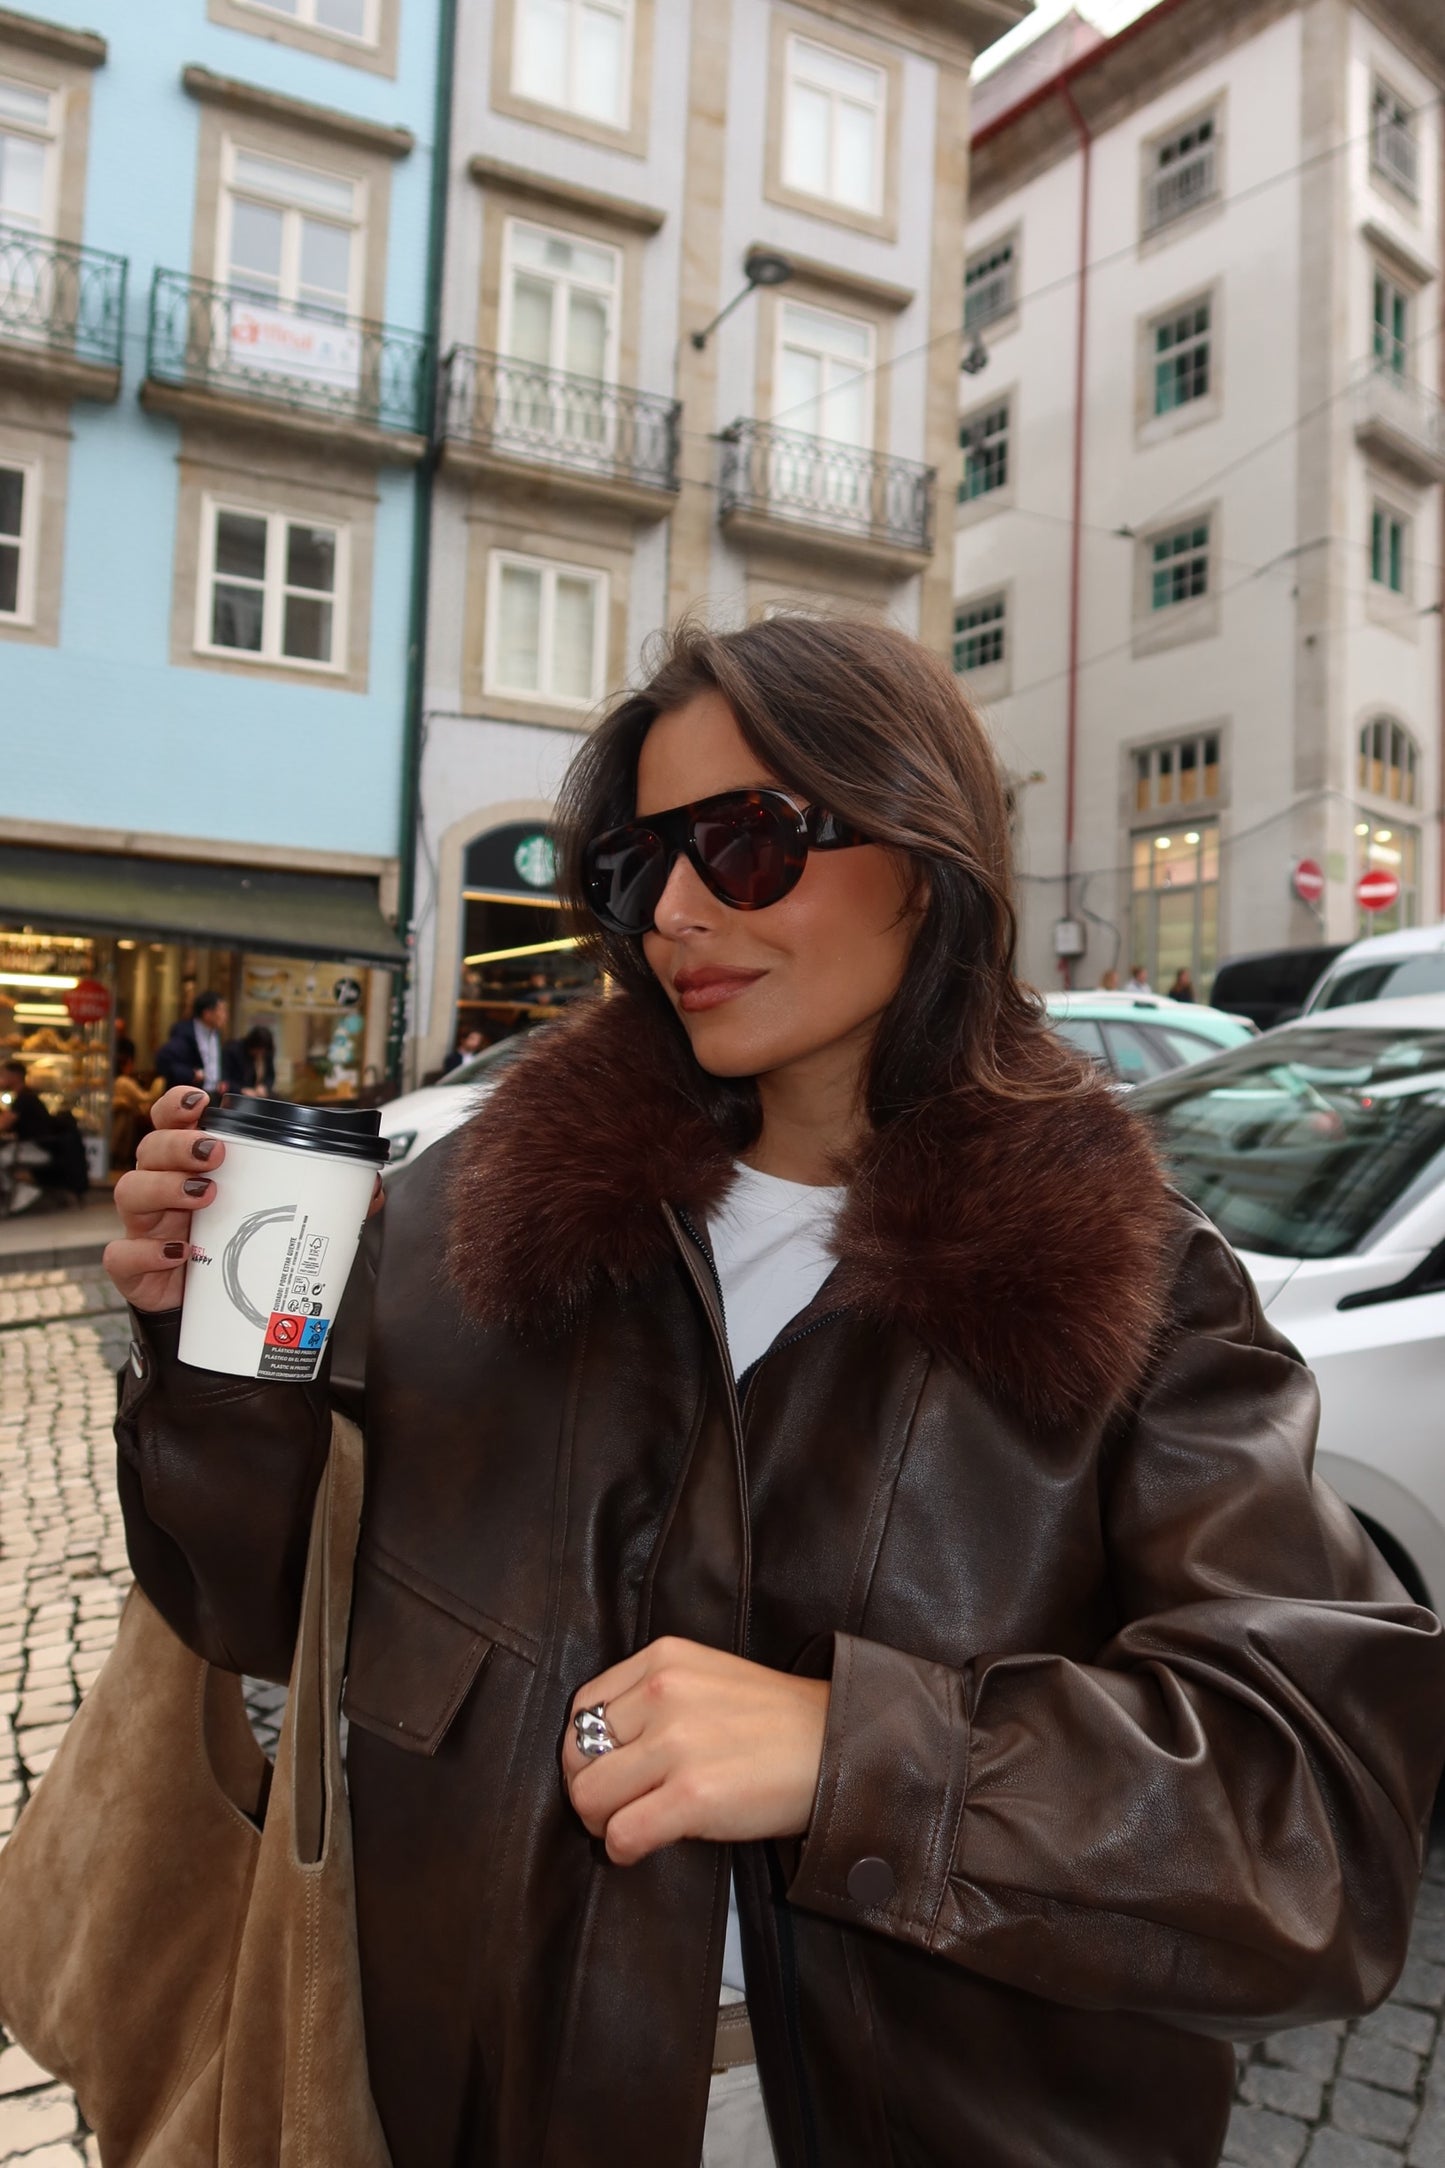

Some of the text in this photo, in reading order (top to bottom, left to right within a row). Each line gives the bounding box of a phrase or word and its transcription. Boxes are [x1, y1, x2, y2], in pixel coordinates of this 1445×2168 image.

[279, 1273, 287, 1287] PODE
[283, 1256, 291, 1273] ESTAR
[287, 1237, 297, 1256] QUENTE
